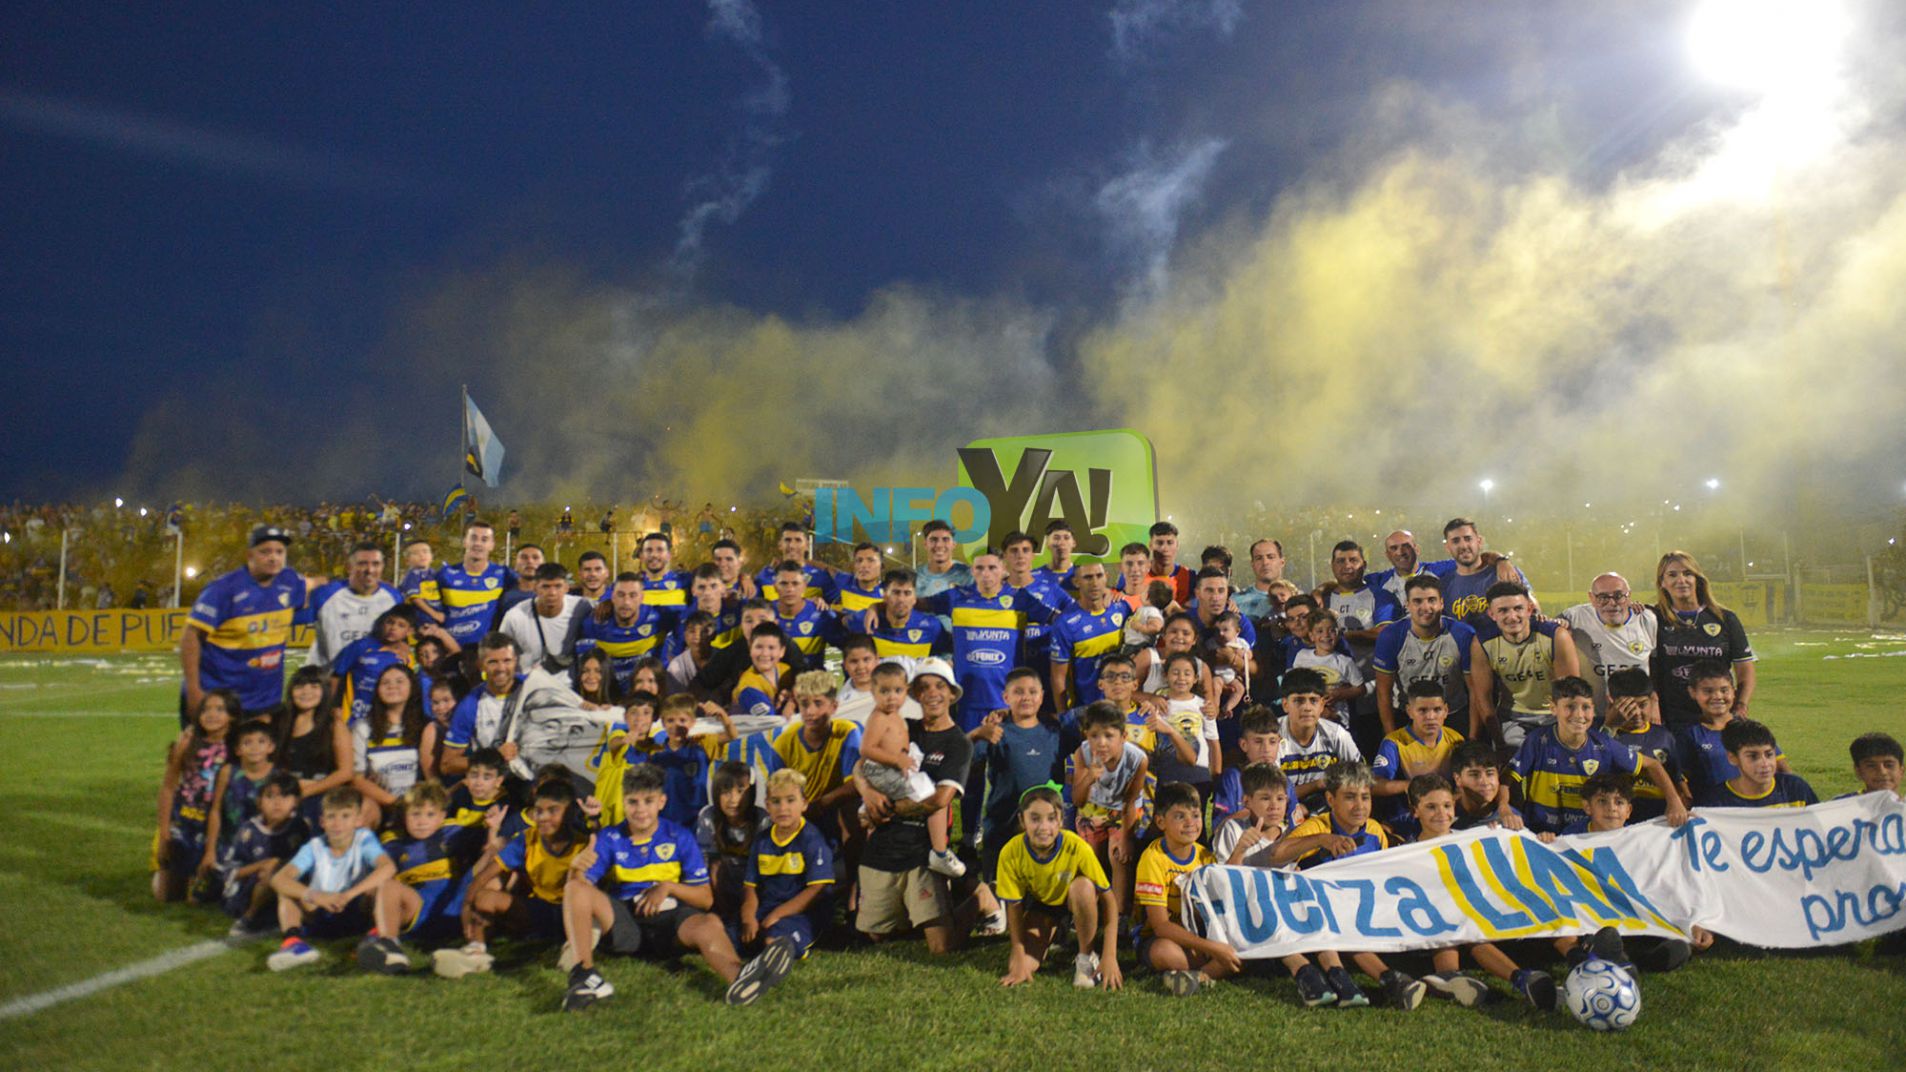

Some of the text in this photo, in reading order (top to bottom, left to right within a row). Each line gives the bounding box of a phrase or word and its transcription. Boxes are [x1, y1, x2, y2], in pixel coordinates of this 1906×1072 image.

[67, 614, 112, 646] DE
[1671, 817, 1729, 873] Te
[1800, 882, 1906, 941] pro
